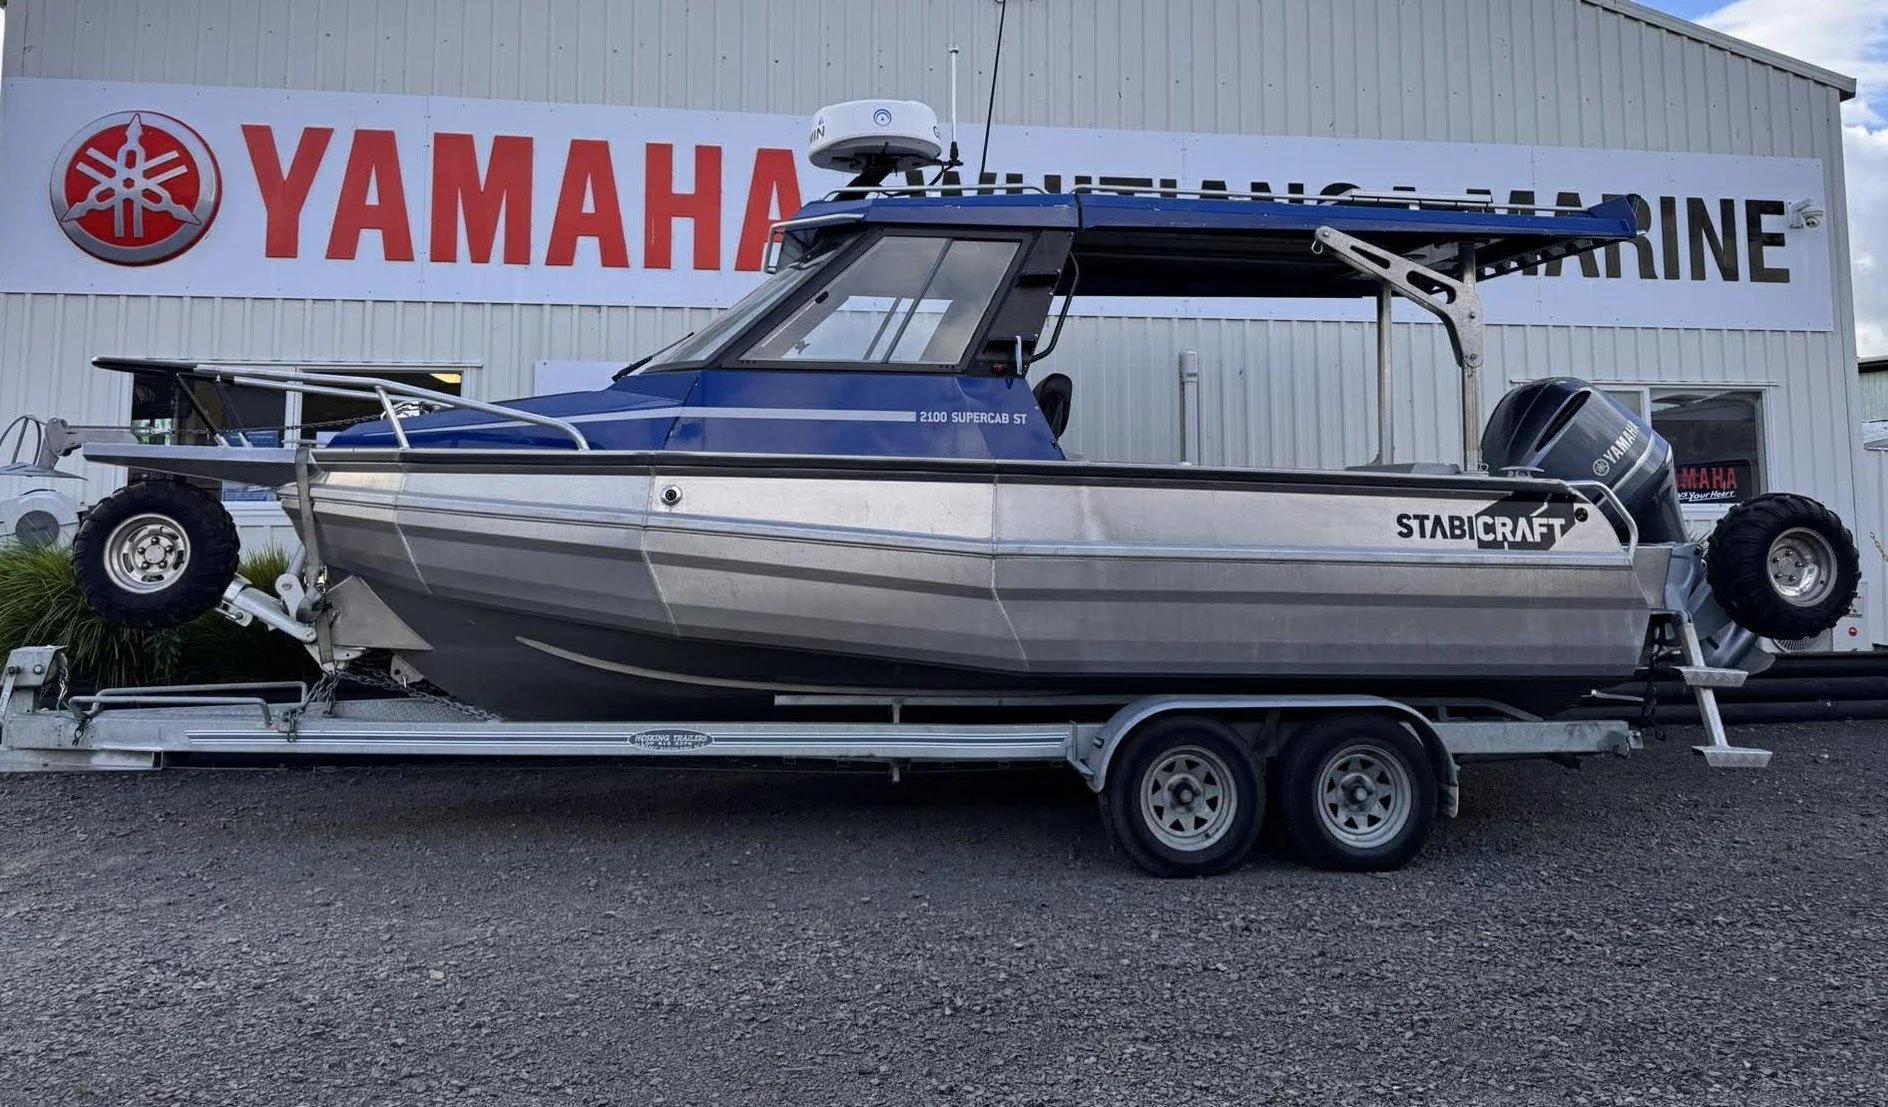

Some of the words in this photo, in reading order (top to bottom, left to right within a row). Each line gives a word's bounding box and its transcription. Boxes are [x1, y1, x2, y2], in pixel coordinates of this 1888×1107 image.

[241, 124, 802, 271] YAMAHA
[919, 411, 948, 423] 2100
[951, 412, 1009, 424] SUPERCAB
[1013, 413, 1028, 425] ST
[1396, 513, 1566, 543] STABICRAFT
